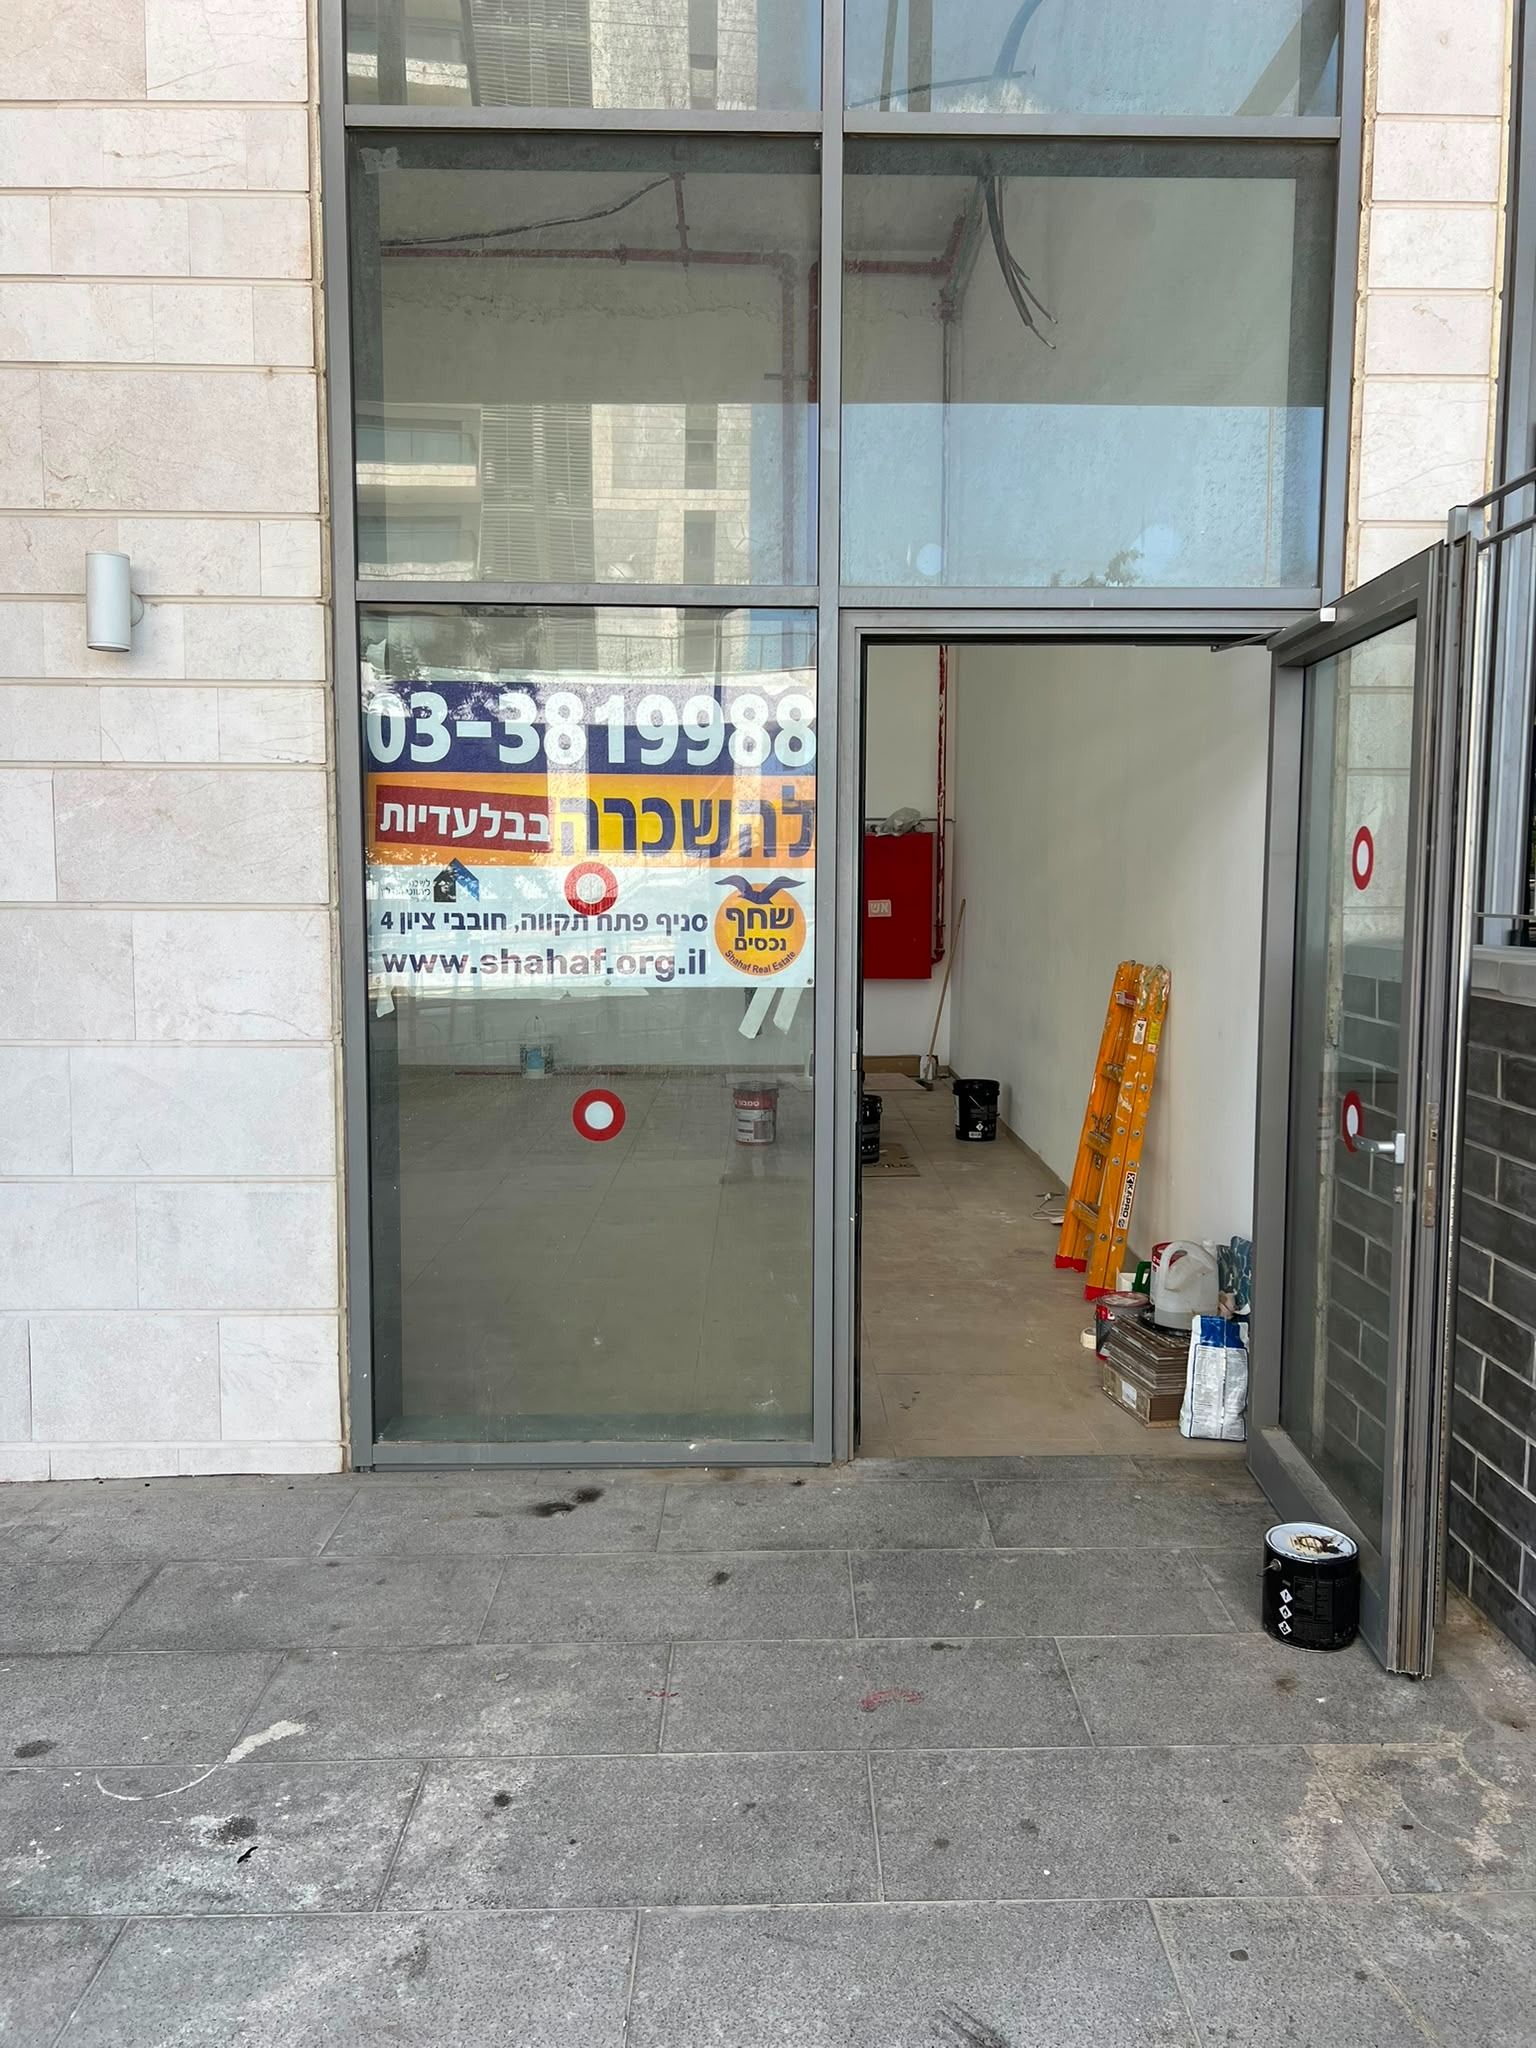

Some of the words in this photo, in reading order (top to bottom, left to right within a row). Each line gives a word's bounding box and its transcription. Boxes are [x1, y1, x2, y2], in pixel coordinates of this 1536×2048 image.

[366, 691, 817, 768] 03-3819988
[380, 803, 550, 842] בבלעדיות
[559, 786, 815, 858] להשכרה
[871, 903, 889, 914] אש
[380, 911, 394, 930] 4
[400, 911, 436, 935] ציון
[443, 912, 507, 931] חובבי
[514, 913, 589, 936] תקווה,
[598, 914, 648, 932] פתח
[656, 914, 708, 936] סניף
[726, 908, 795, 937] שחף
[735, 938, 786, 951] נכסים
[382, 948, 707, 982] www.shahaf.org.il
[725, 950, 752, 971] Shahaf
[752, 964, 772, 973] Real
[772, 950, 797, 970] Estate
